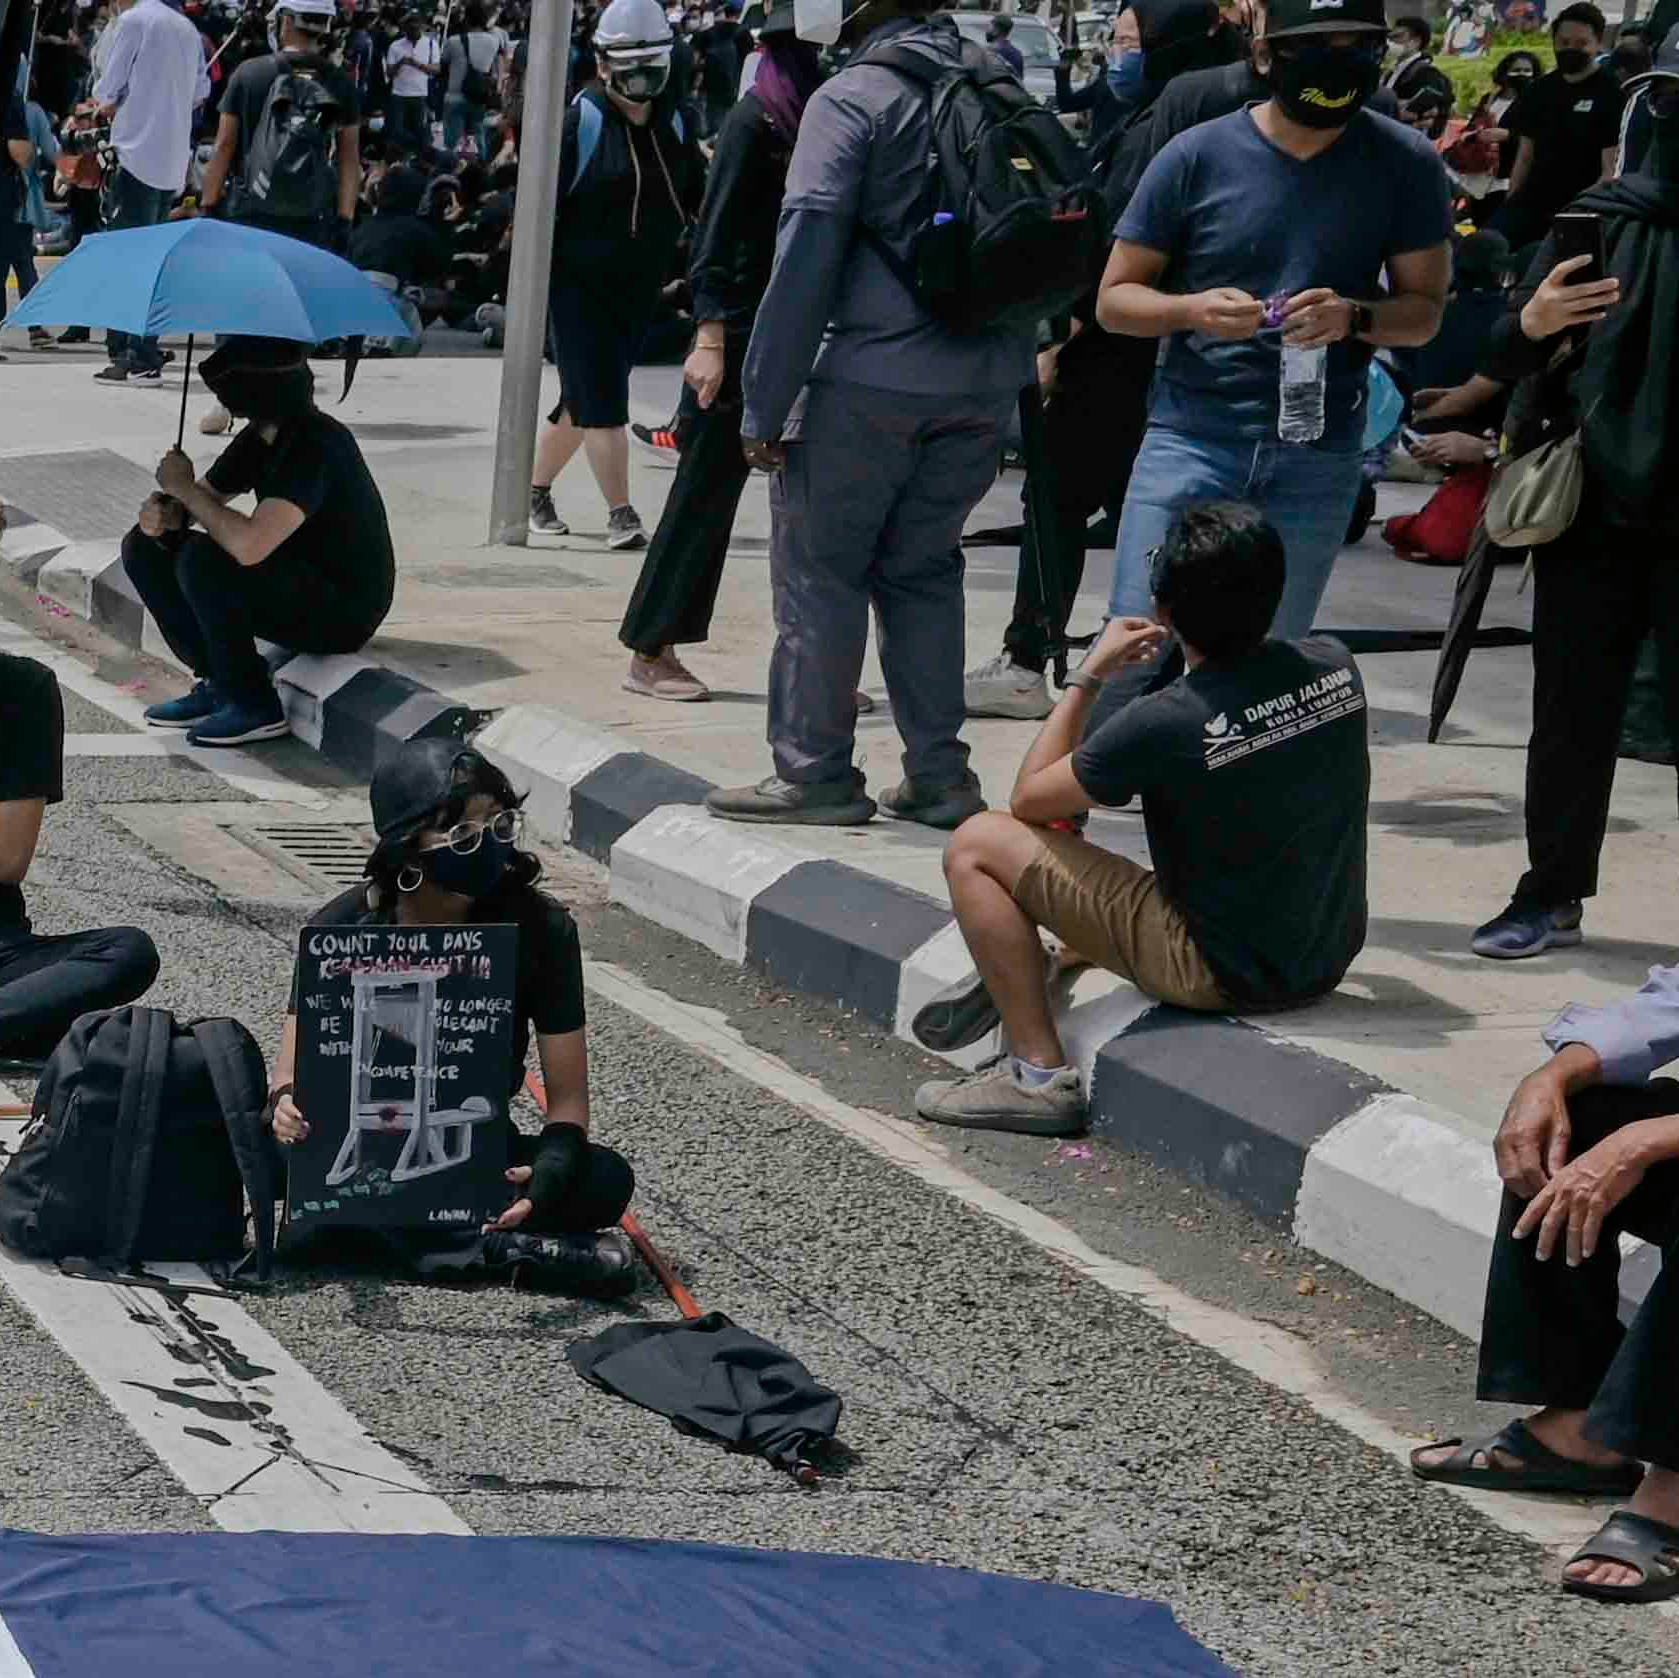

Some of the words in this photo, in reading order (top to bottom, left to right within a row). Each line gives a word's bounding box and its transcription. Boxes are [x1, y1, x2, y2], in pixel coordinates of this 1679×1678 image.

[1243, 692, 1297, 724] DAPUR
[1264, 708, 1306, 729] KUALA
[1307, 685, 1354, 712] LUMPUR
[309, 932, 380, 955] COUNT
[387, 932, 431, 951] YOUR
[442, 931, 483, 950] DAYS
[305, 994, 332, 1010] WE
